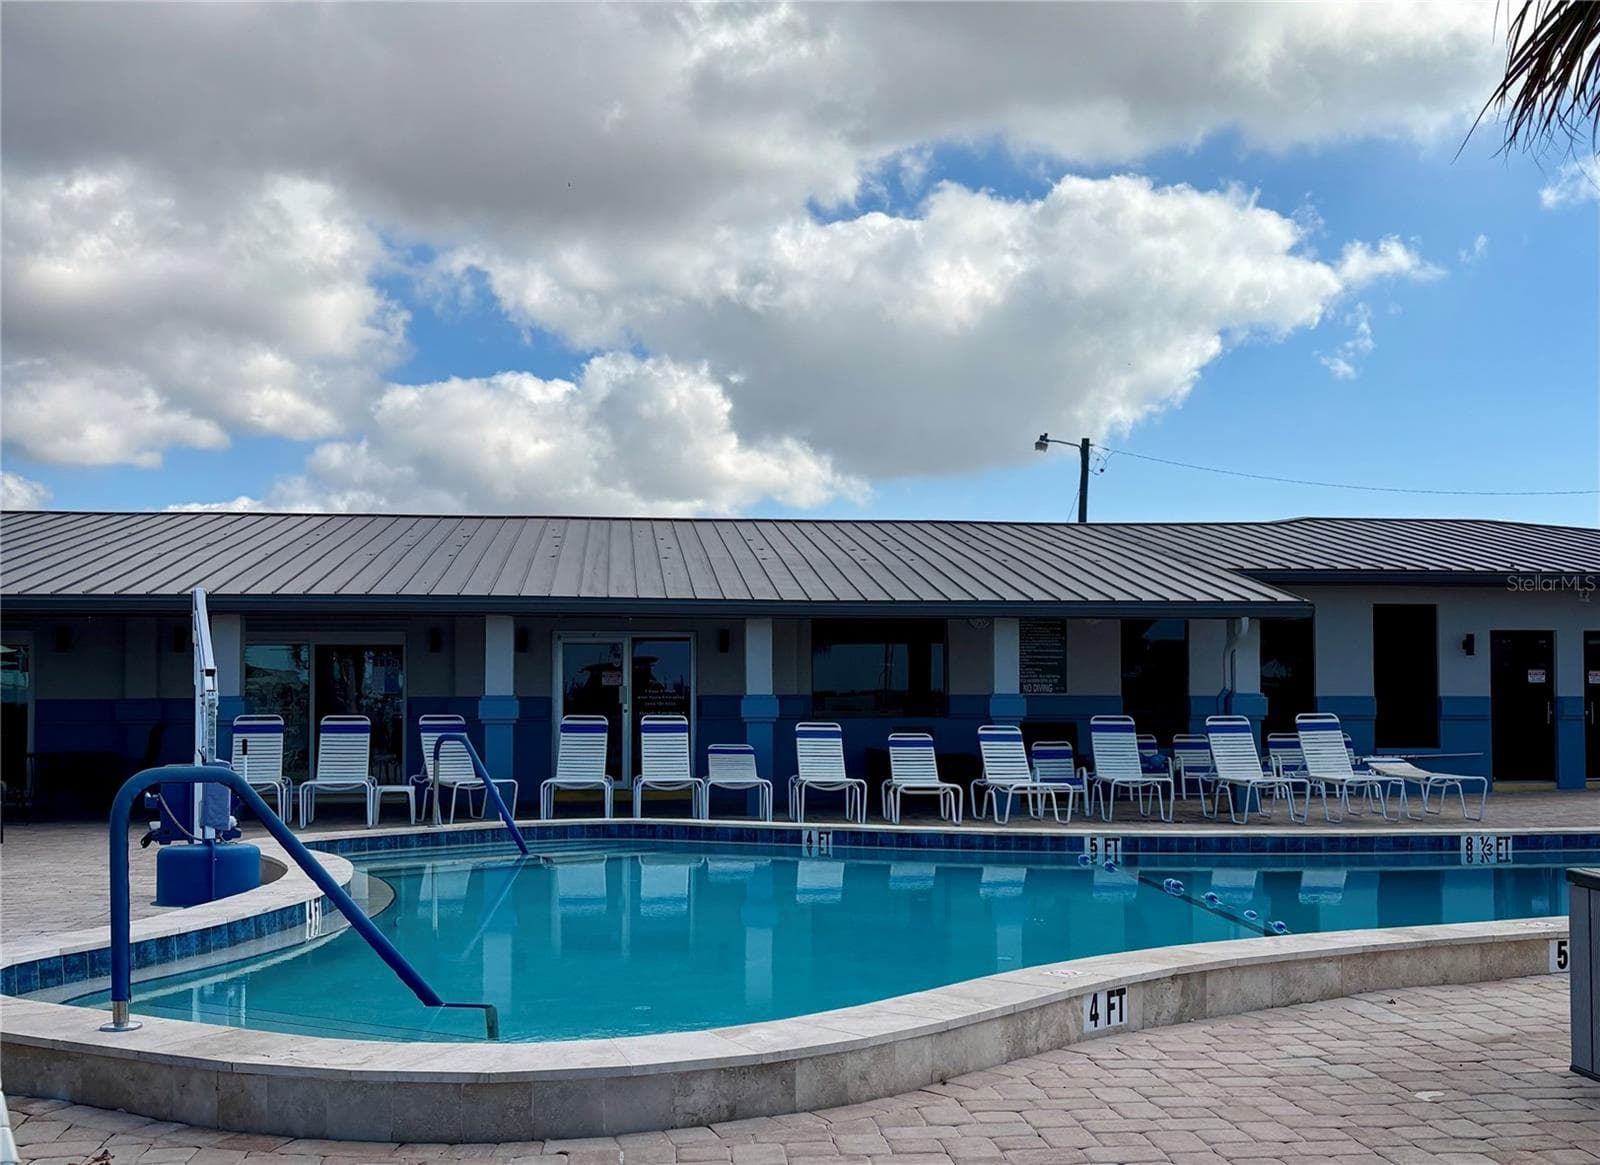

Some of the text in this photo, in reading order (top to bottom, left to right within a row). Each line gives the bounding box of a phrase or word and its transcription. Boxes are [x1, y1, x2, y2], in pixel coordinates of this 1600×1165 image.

[1023, 683, 1053, 693] NO DIVING
[1089, 837, 1121, 853] 5 FT
[1496, 836, 1511, 851] FT
[1557, 940, 1568, 970] 5
[1089, 987, 1126, 1028] 4 FT
